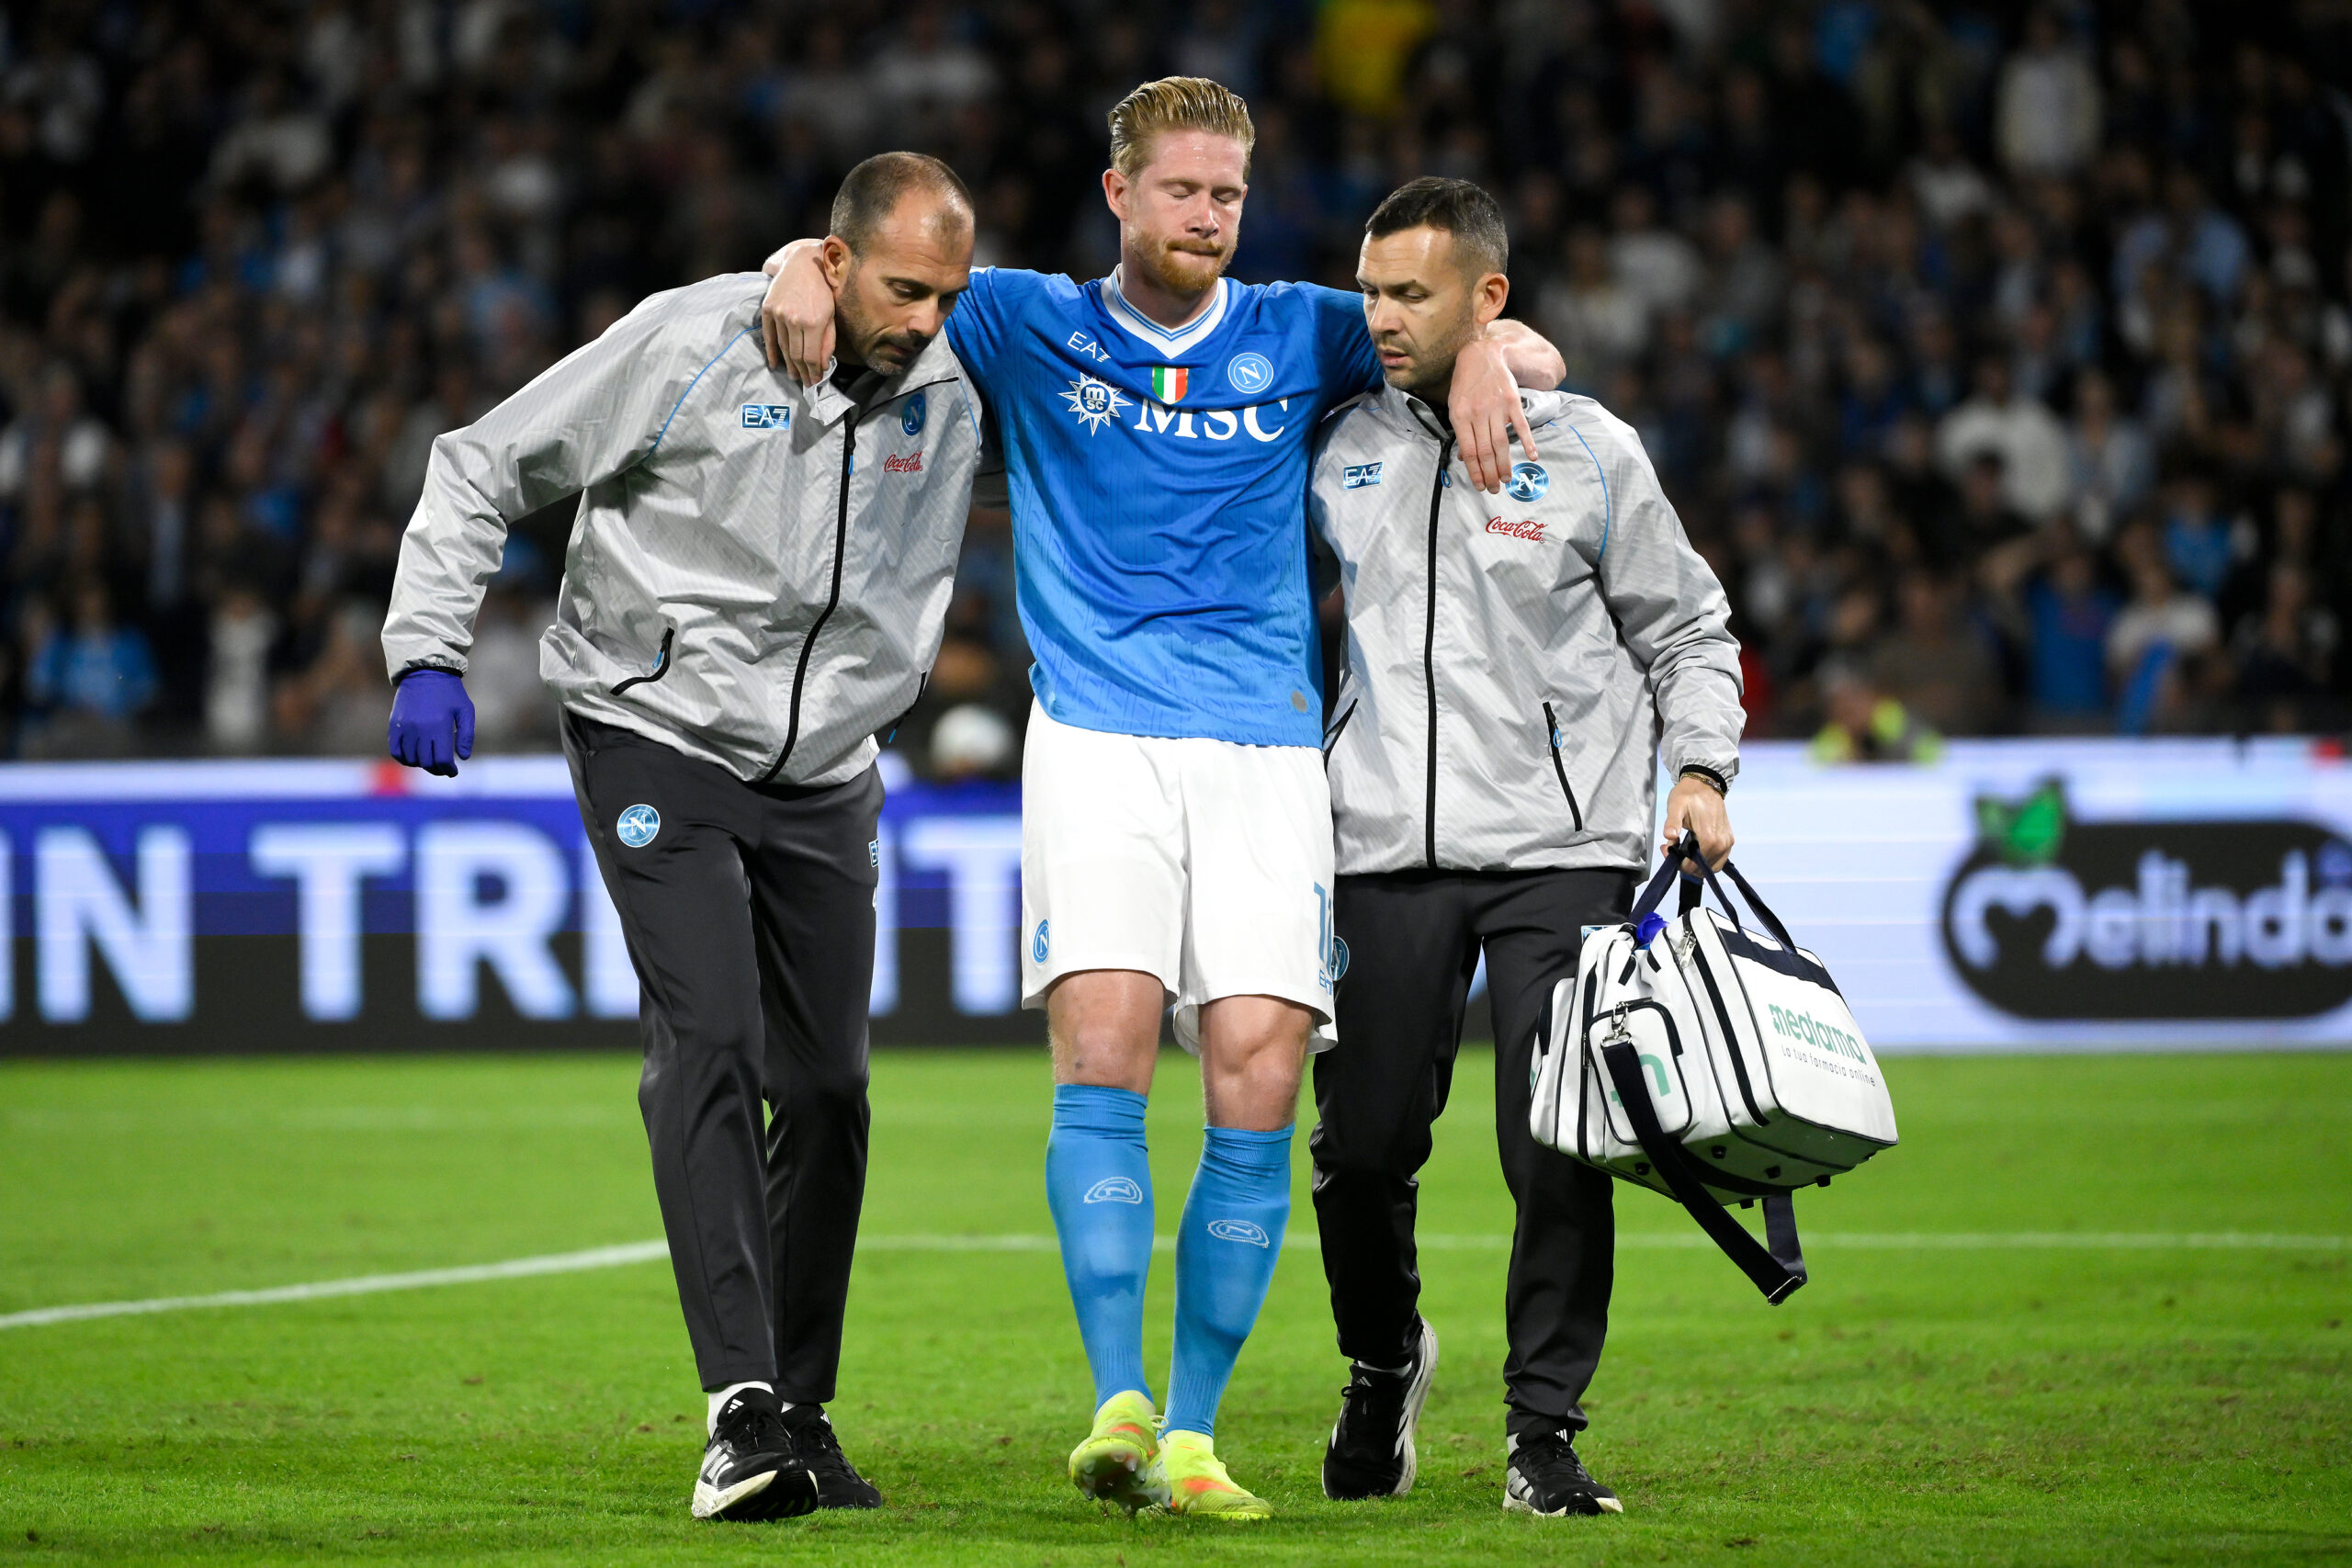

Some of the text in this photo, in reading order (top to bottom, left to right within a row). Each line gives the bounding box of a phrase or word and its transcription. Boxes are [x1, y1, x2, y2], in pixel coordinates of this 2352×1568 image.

[1067, 331, 1112, 363] EA7
[1238, 362, 1261, 385] N
[744, 408, 789, 427] EA7
[1134, 397, 1288, 443] MSC
[1345, 465, 1380, 486] EA7
[1517, 472, 1538, 493] N
[629, 814, 648, 836] N
[0, 822, 194, 1021] N
[1810, 1053, 1847, 1077] farmacia
[1849, 1068, 1876, 1087] online
